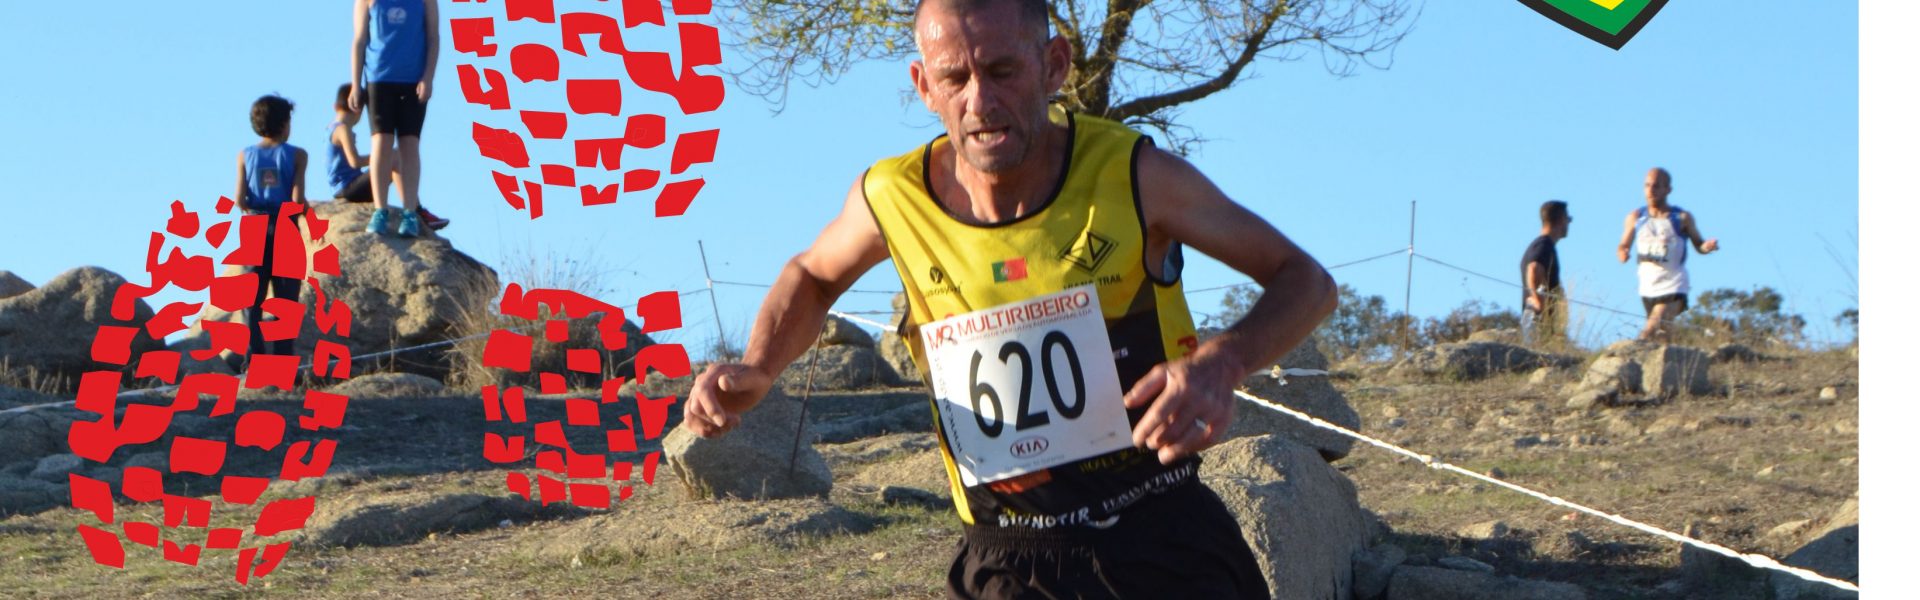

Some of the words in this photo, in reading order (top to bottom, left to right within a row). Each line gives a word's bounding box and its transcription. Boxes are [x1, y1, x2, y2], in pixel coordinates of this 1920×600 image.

[1098, 272, 1122, 287] TRAIL
[957, 291, 1090, 337] MULTIRIBEIRO
[968, 330, 1086, 438] 620
[1014, 438, 1044, 457] KIA
